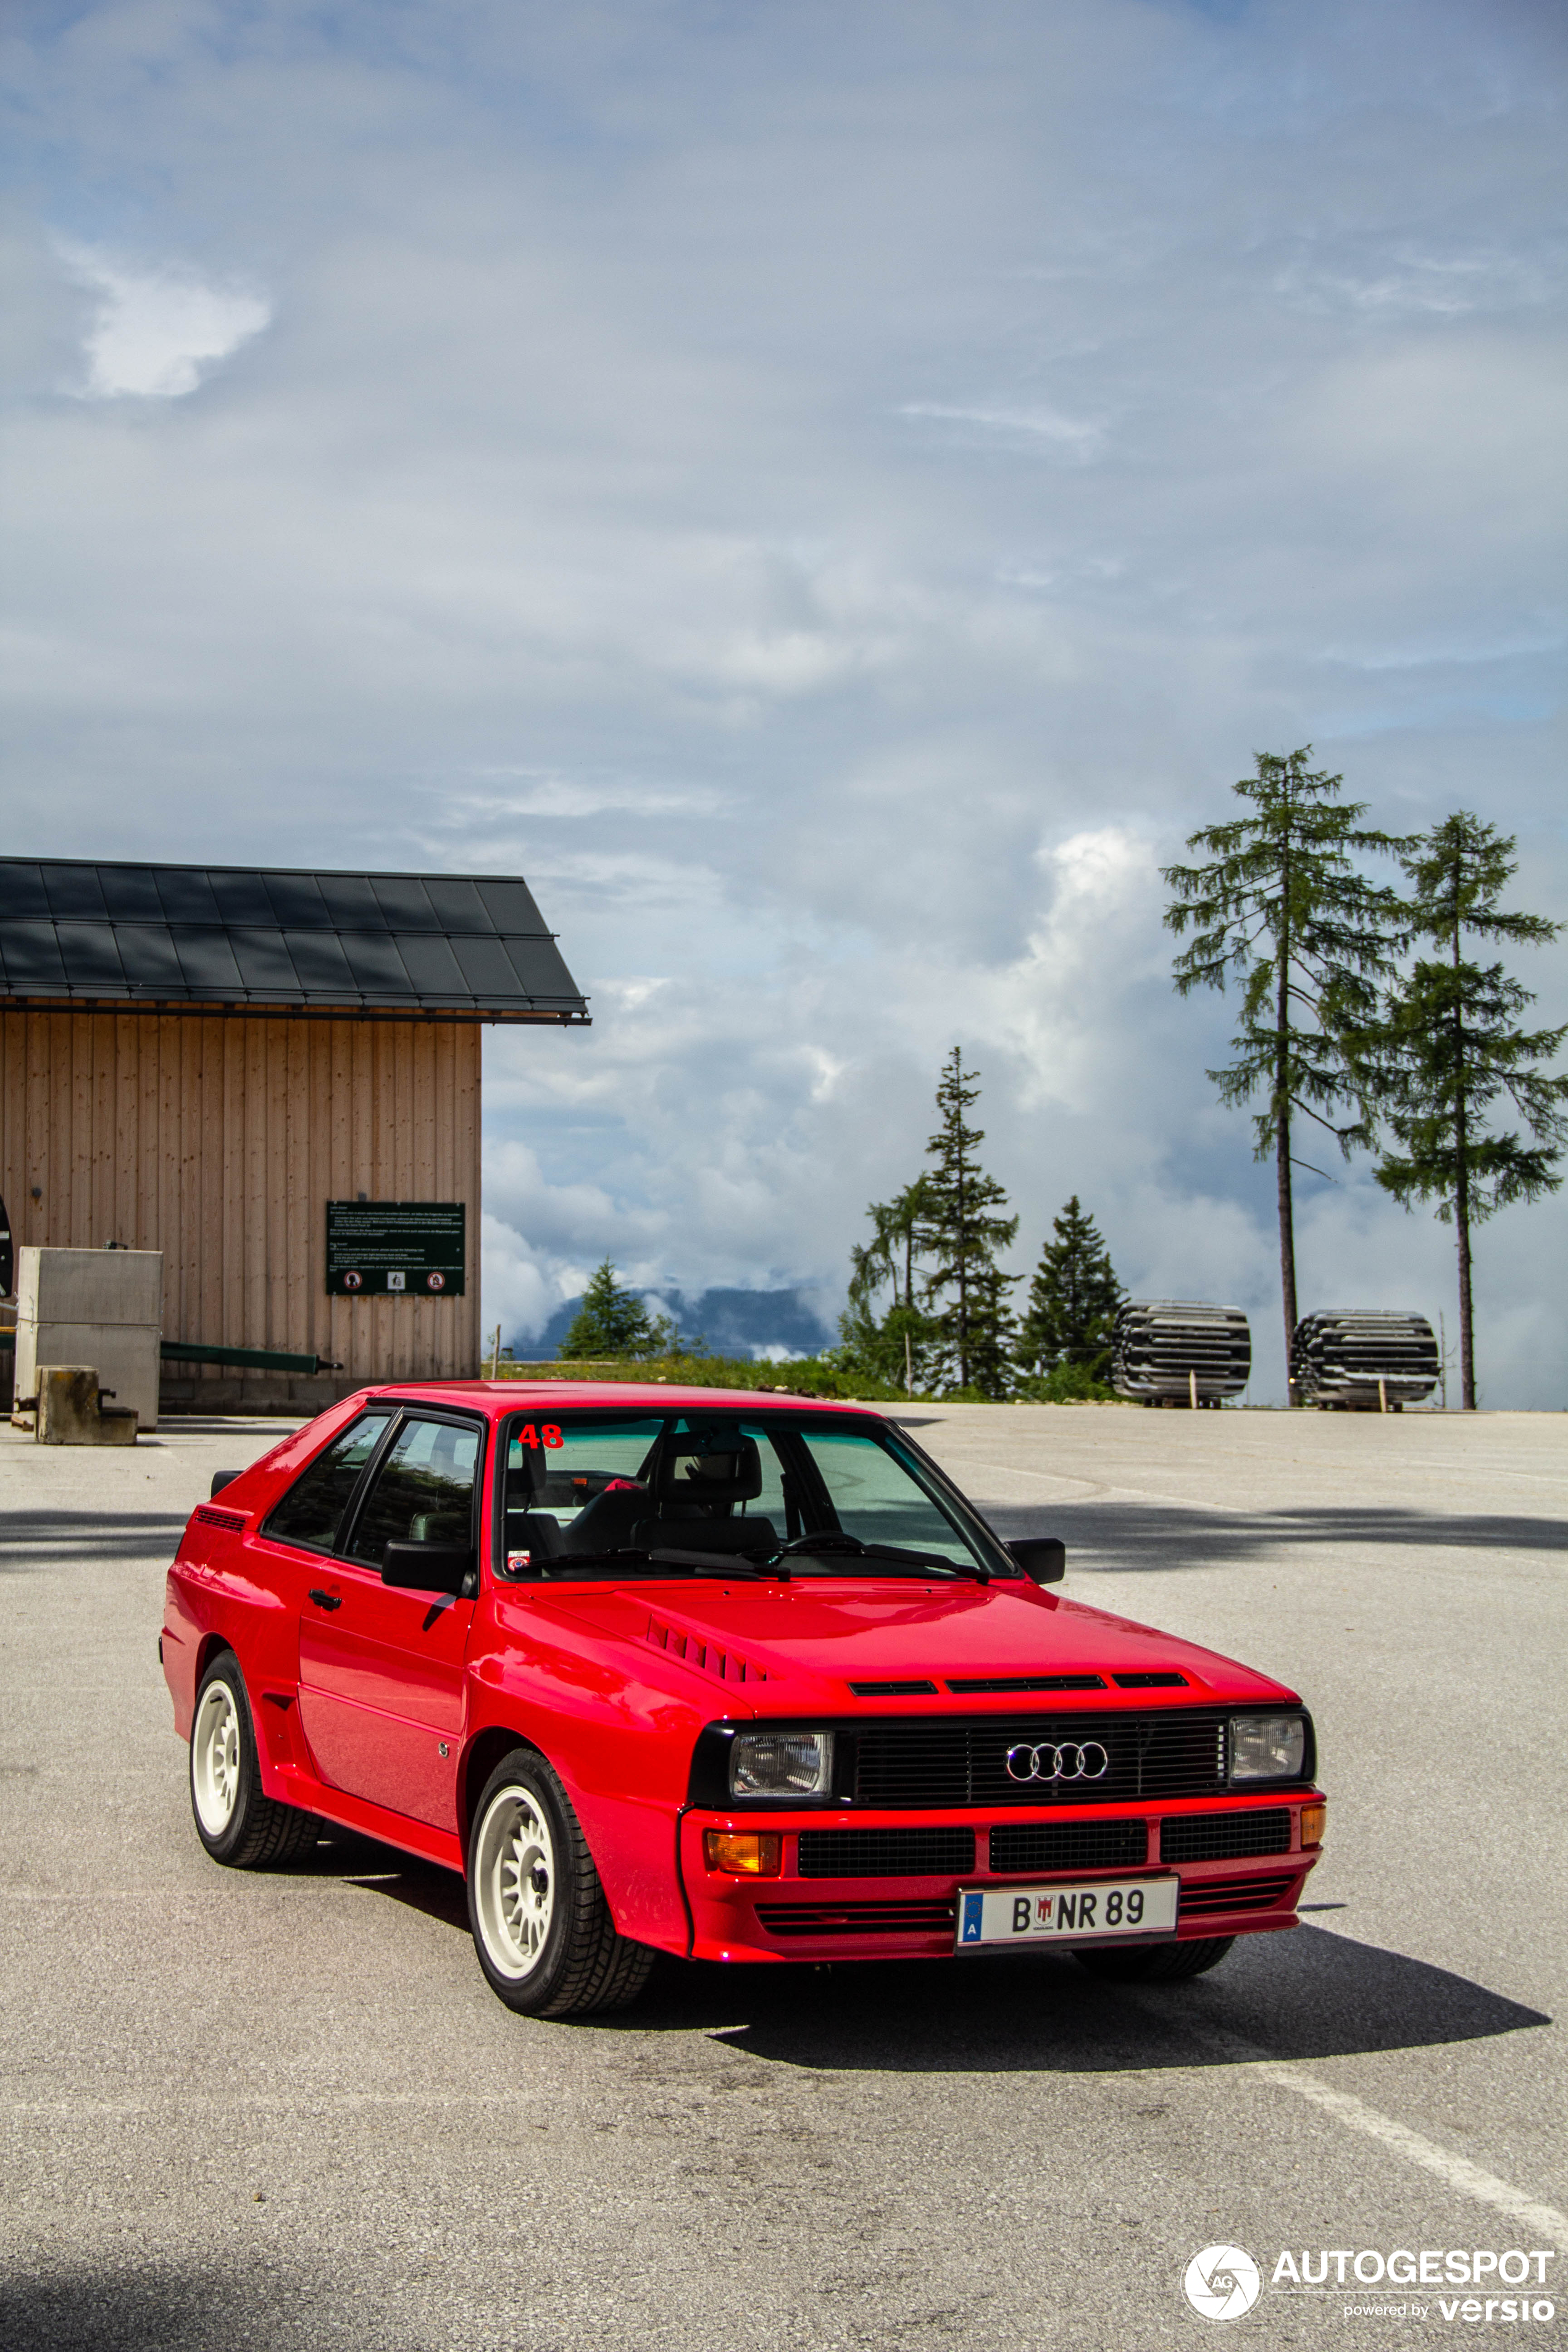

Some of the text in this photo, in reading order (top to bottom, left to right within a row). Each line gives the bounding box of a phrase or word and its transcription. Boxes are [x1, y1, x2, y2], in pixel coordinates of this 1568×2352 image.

[518, 1424, 565, 1449] 48
[1012, 1888, 1145, 1932] B NR 89
[967, 1924, 977, 1935] A
